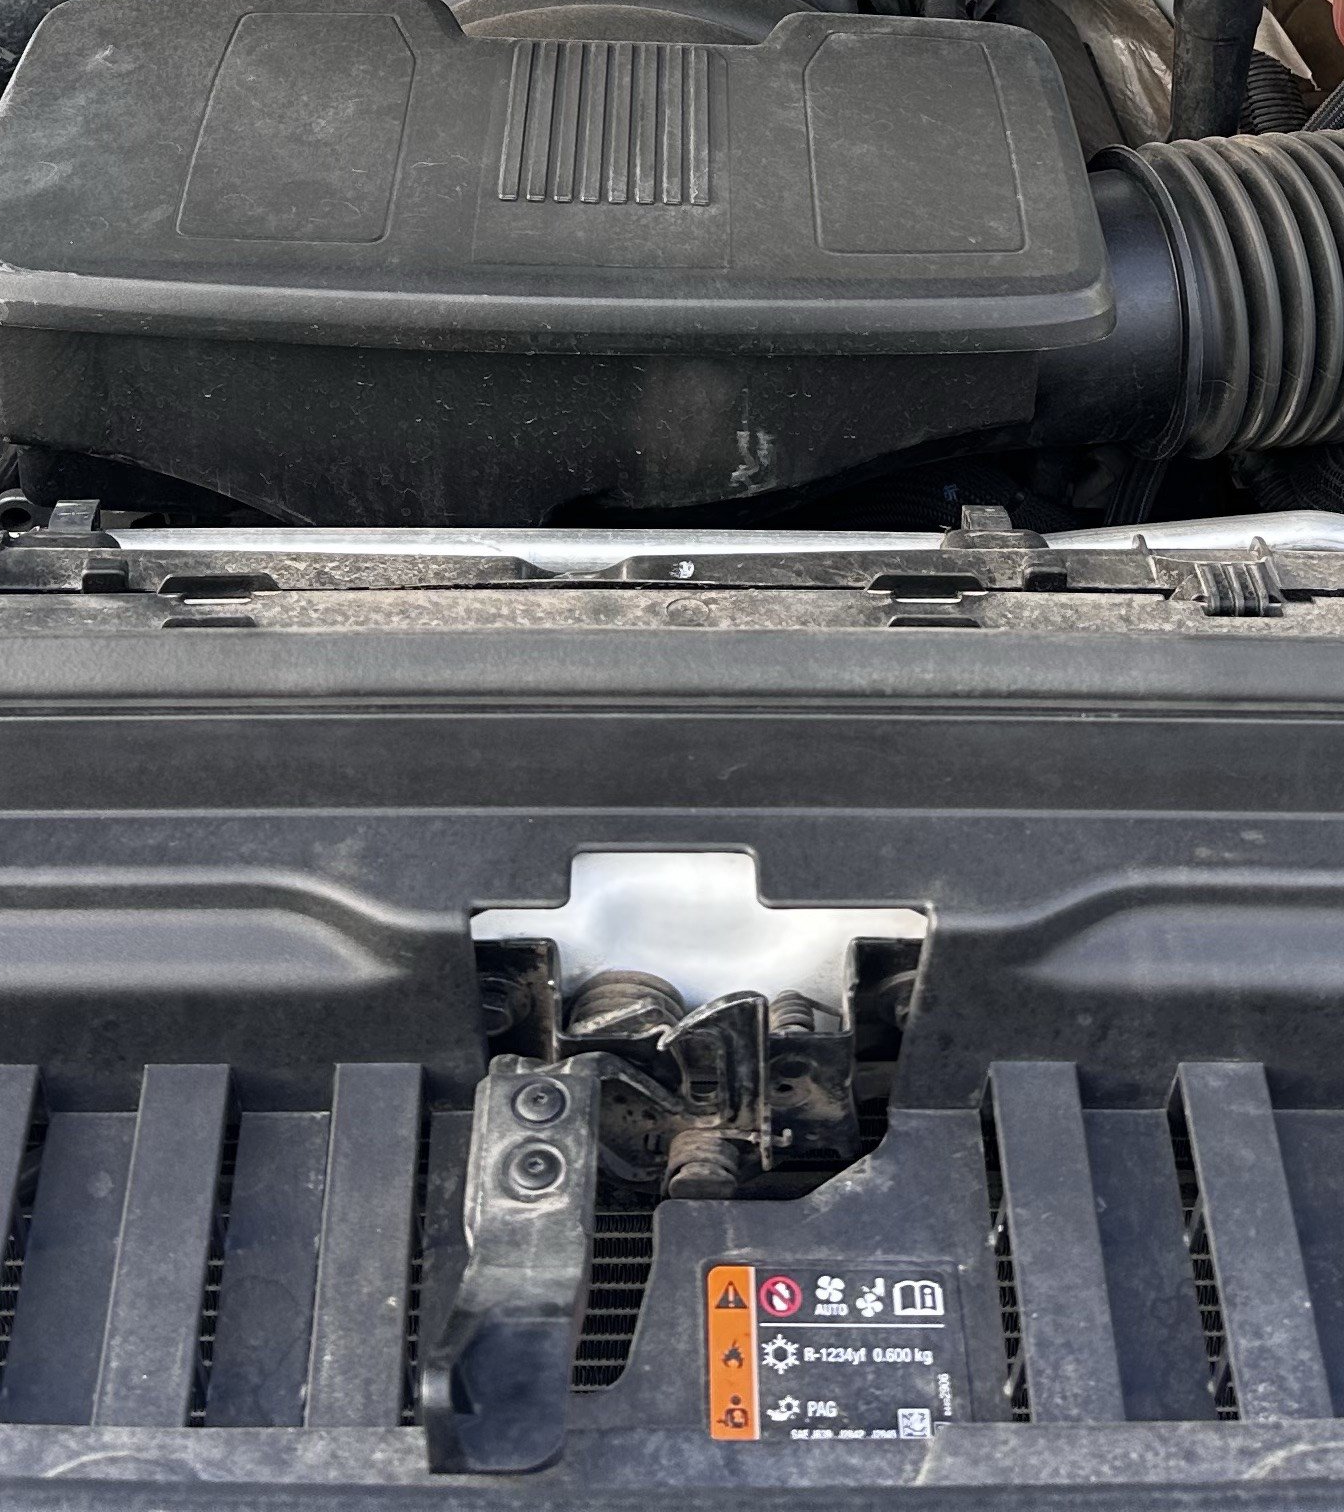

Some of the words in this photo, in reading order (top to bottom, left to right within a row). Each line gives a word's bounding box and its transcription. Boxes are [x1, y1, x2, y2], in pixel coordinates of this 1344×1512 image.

[814, 1303, 849, 1316] AUTO
[803, 1347, 867, 1365] R-1234yf
[872, 1347, 913, 1363] 0.600
[913, 1347, 934, 1366] kg
[806, 1400, 839, 1418] PAG
